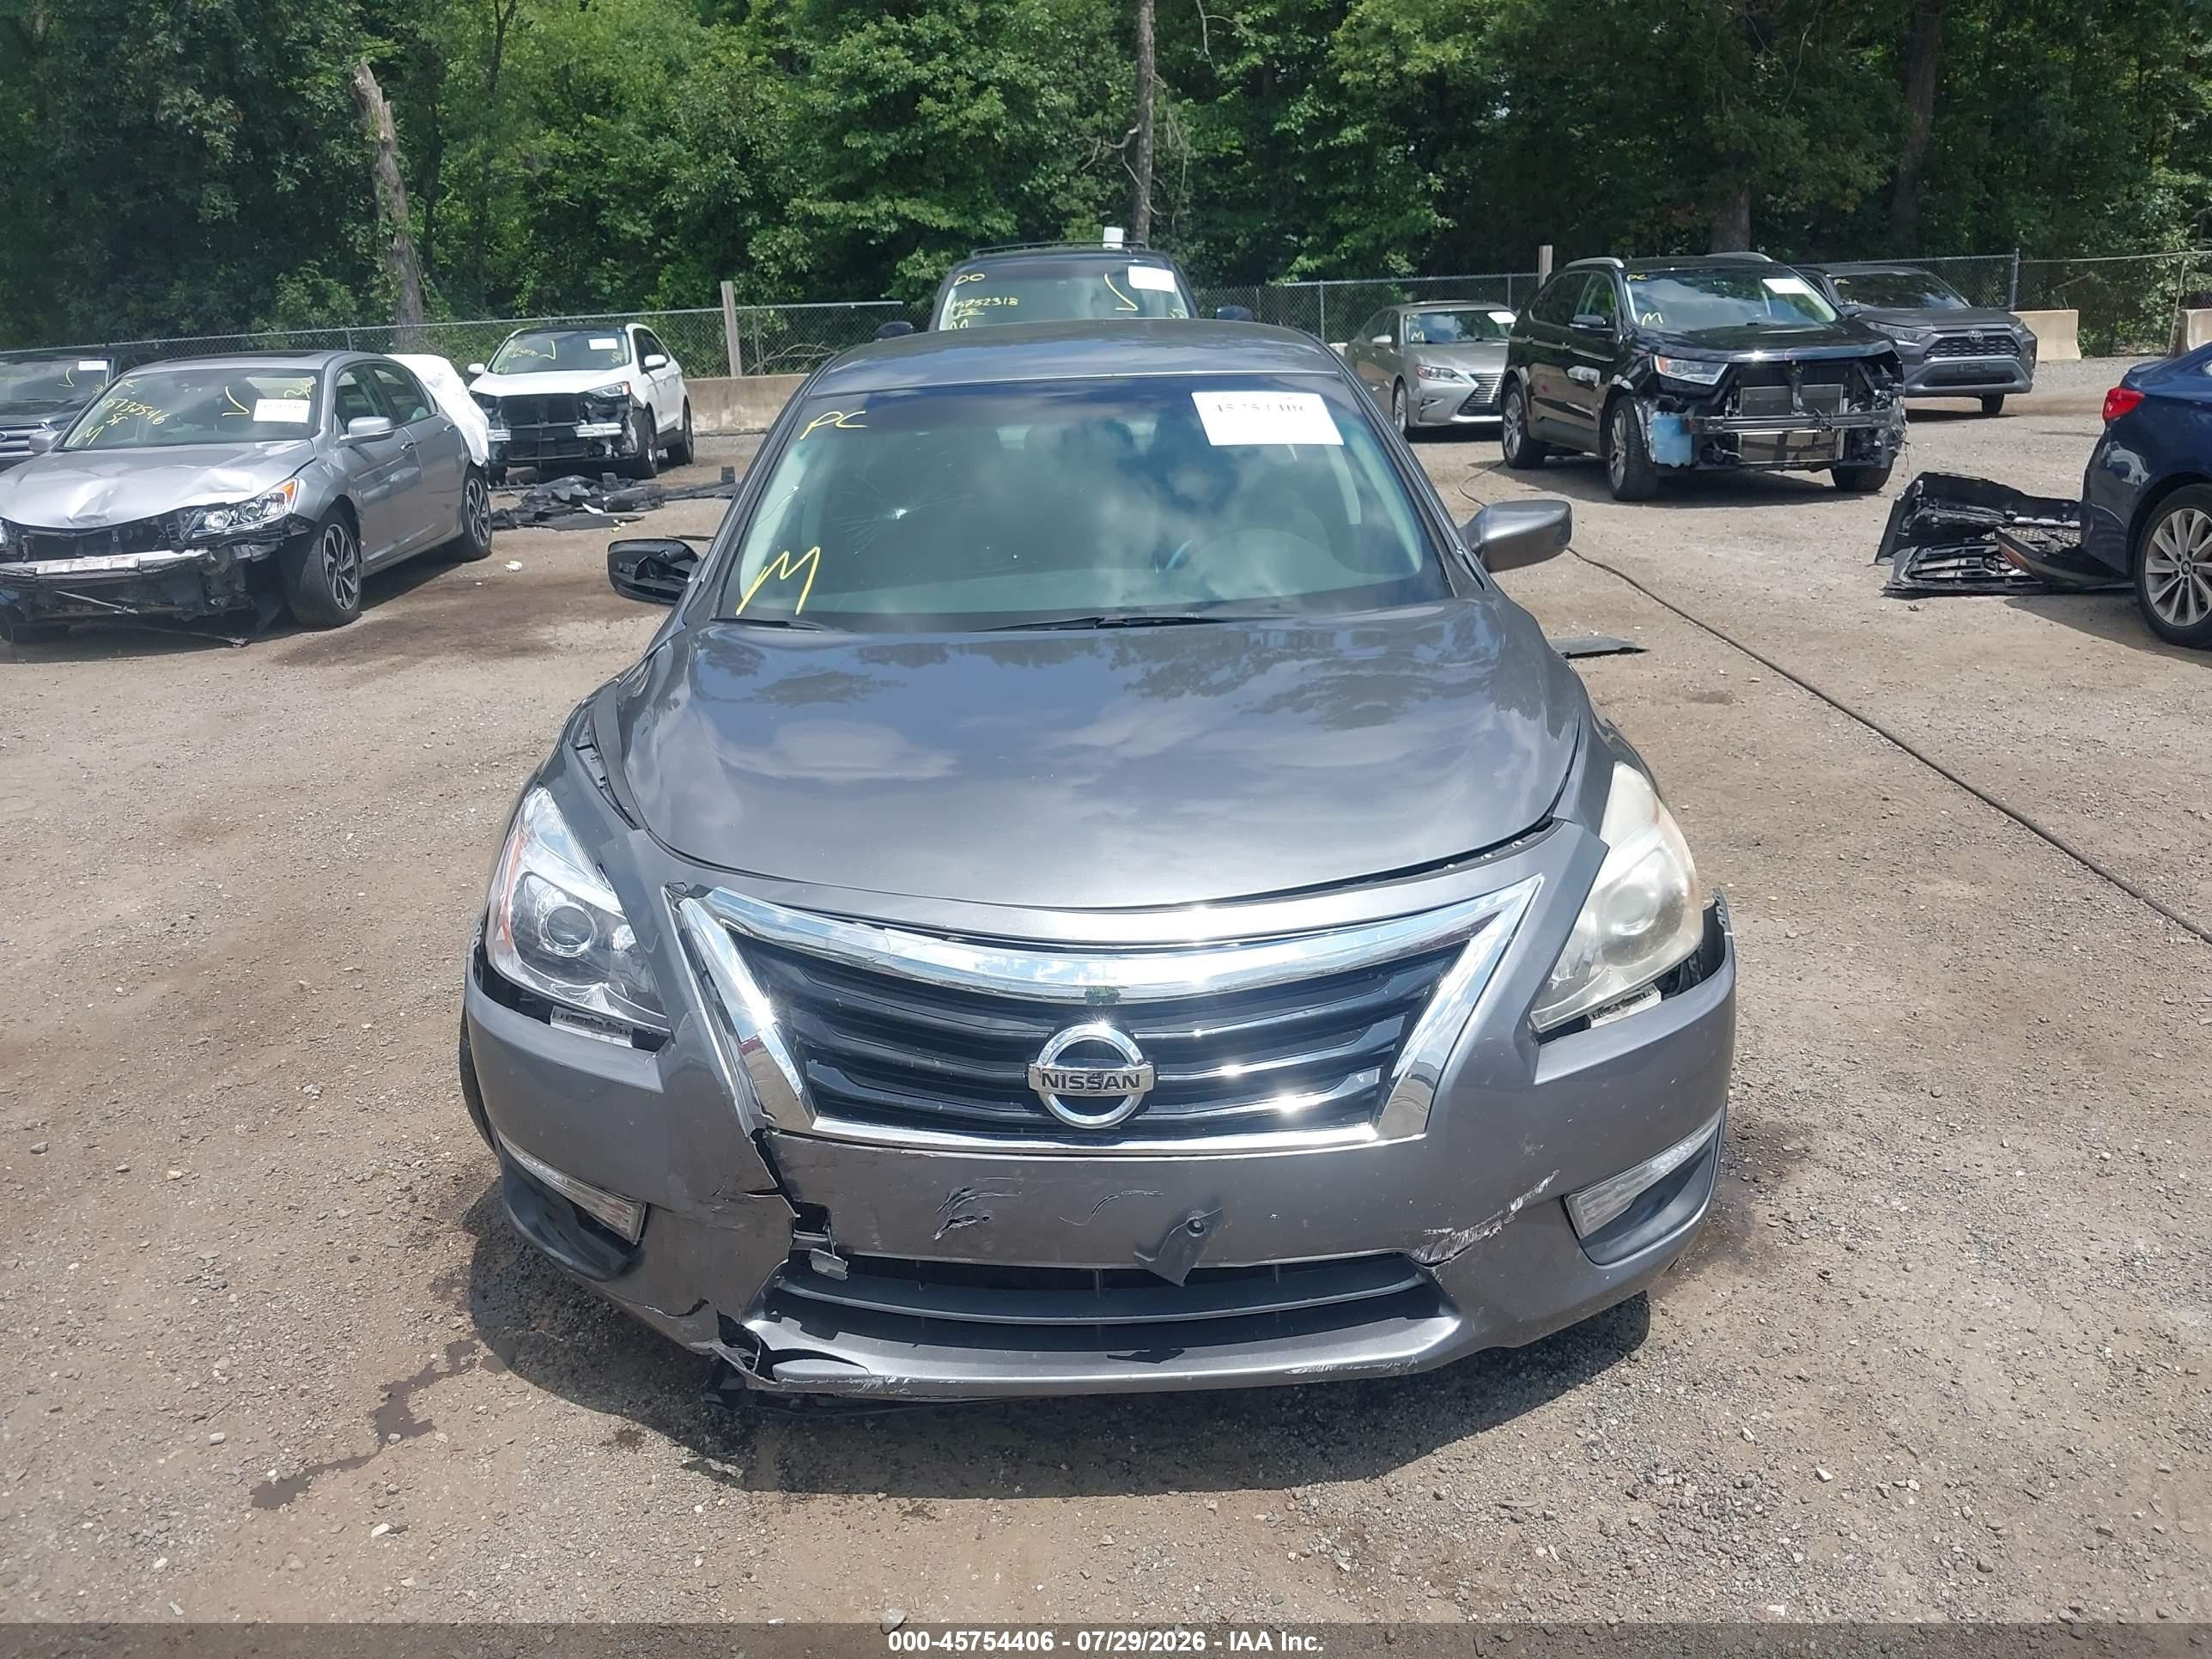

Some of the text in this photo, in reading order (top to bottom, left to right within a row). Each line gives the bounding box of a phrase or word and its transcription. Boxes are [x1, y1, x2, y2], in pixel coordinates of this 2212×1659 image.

[1641, 312, 1664, 326] M
[70, 425, 105, 447] M
[799, 410, 868, 441] PC
[735, 545, 821, 616] M
[1042, 1073, 1140, 1091] NISSAN
